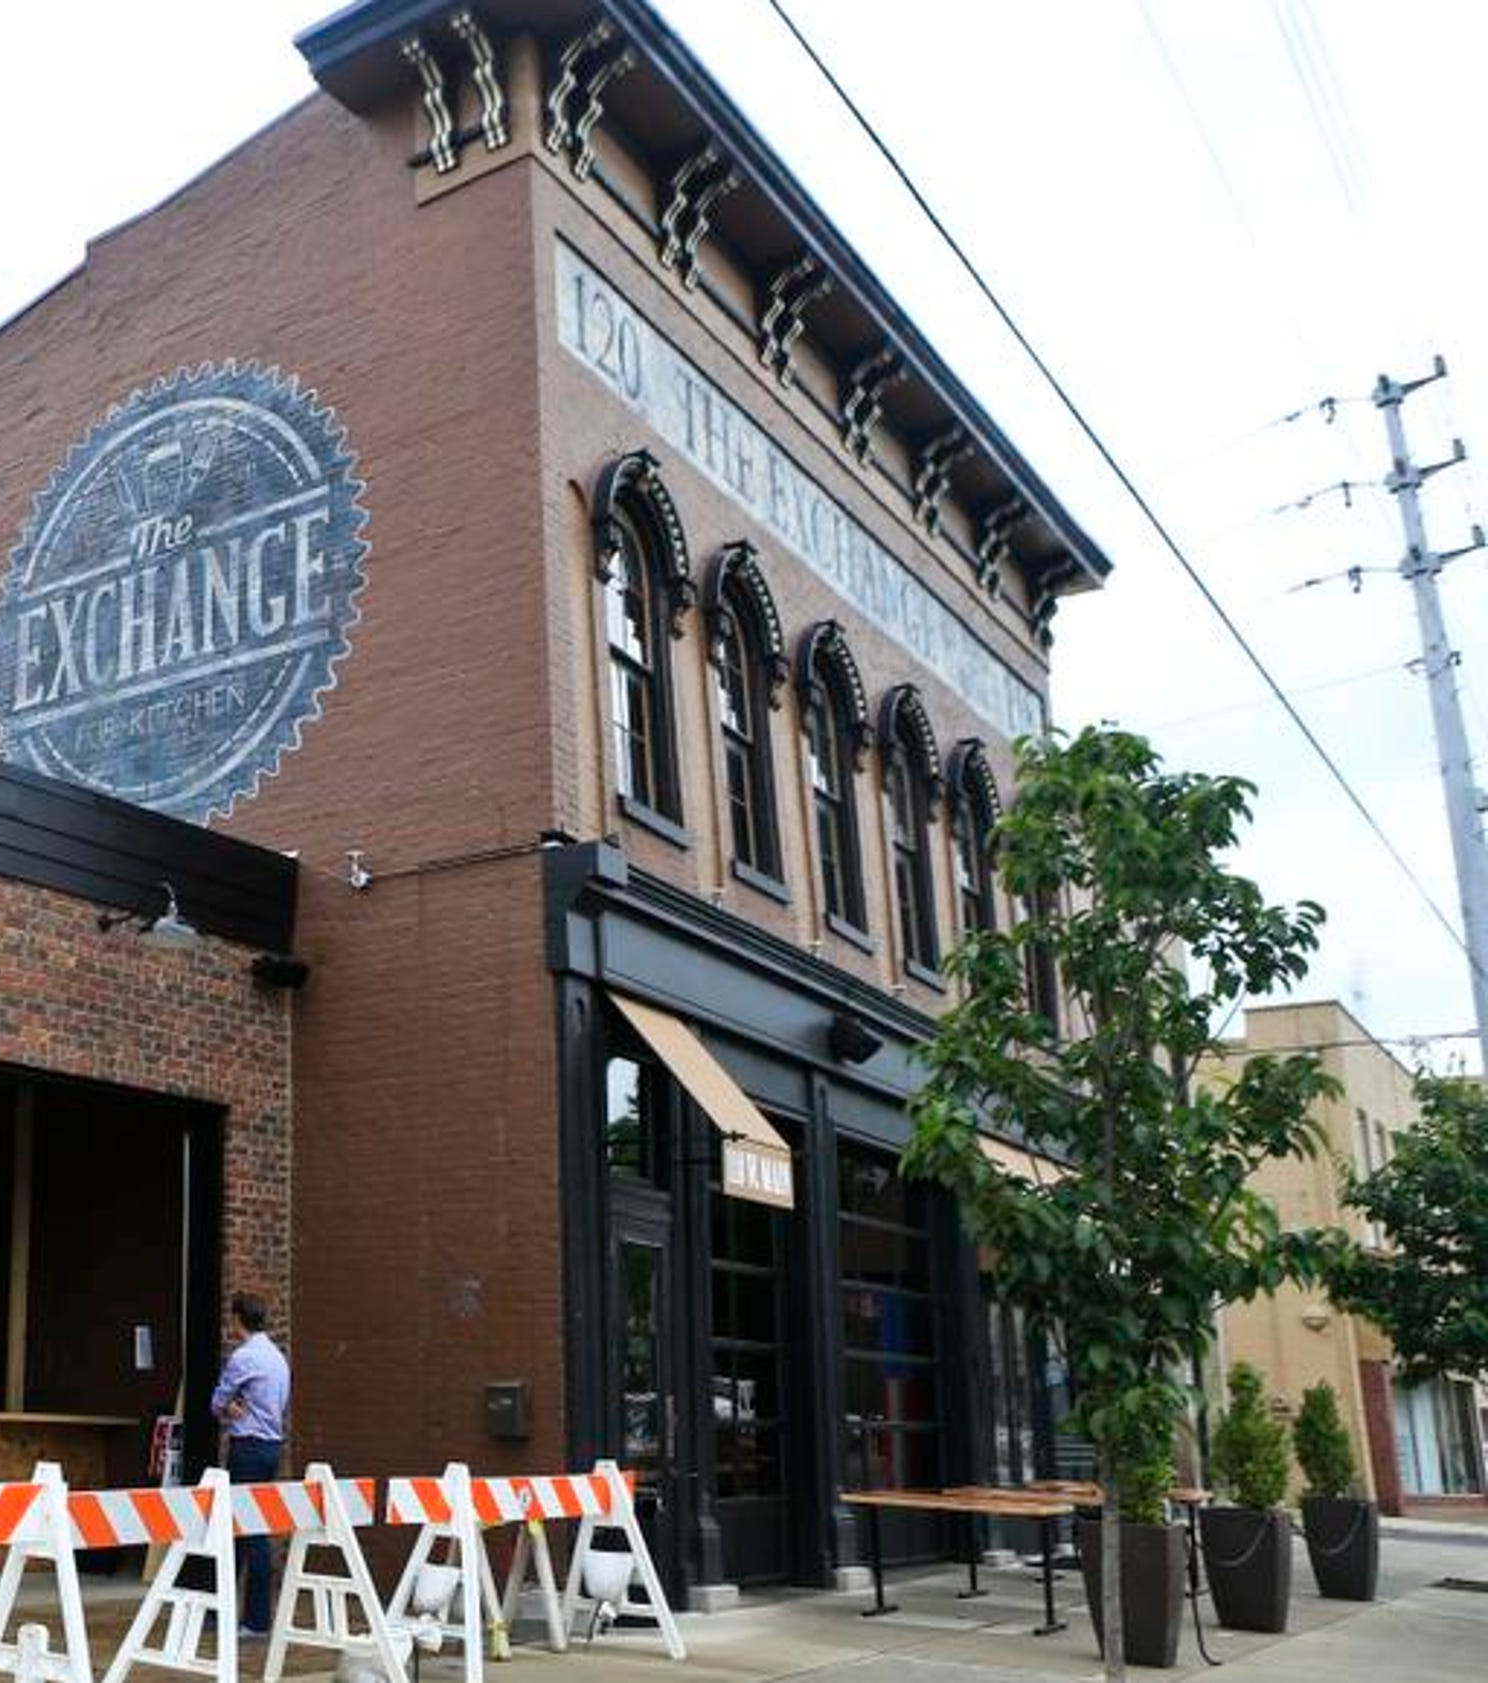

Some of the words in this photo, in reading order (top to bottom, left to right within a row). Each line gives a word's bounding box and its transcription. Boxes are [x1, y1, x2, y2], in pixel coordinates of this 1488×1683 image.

[573, 273, 641, 399] 120
[674, 366, 755, 501] THE
[129, 513, 194, 560] The
[13, 506, 331, 711] EXCHANGE
[128, 683, 246, 737] KITCHEN
